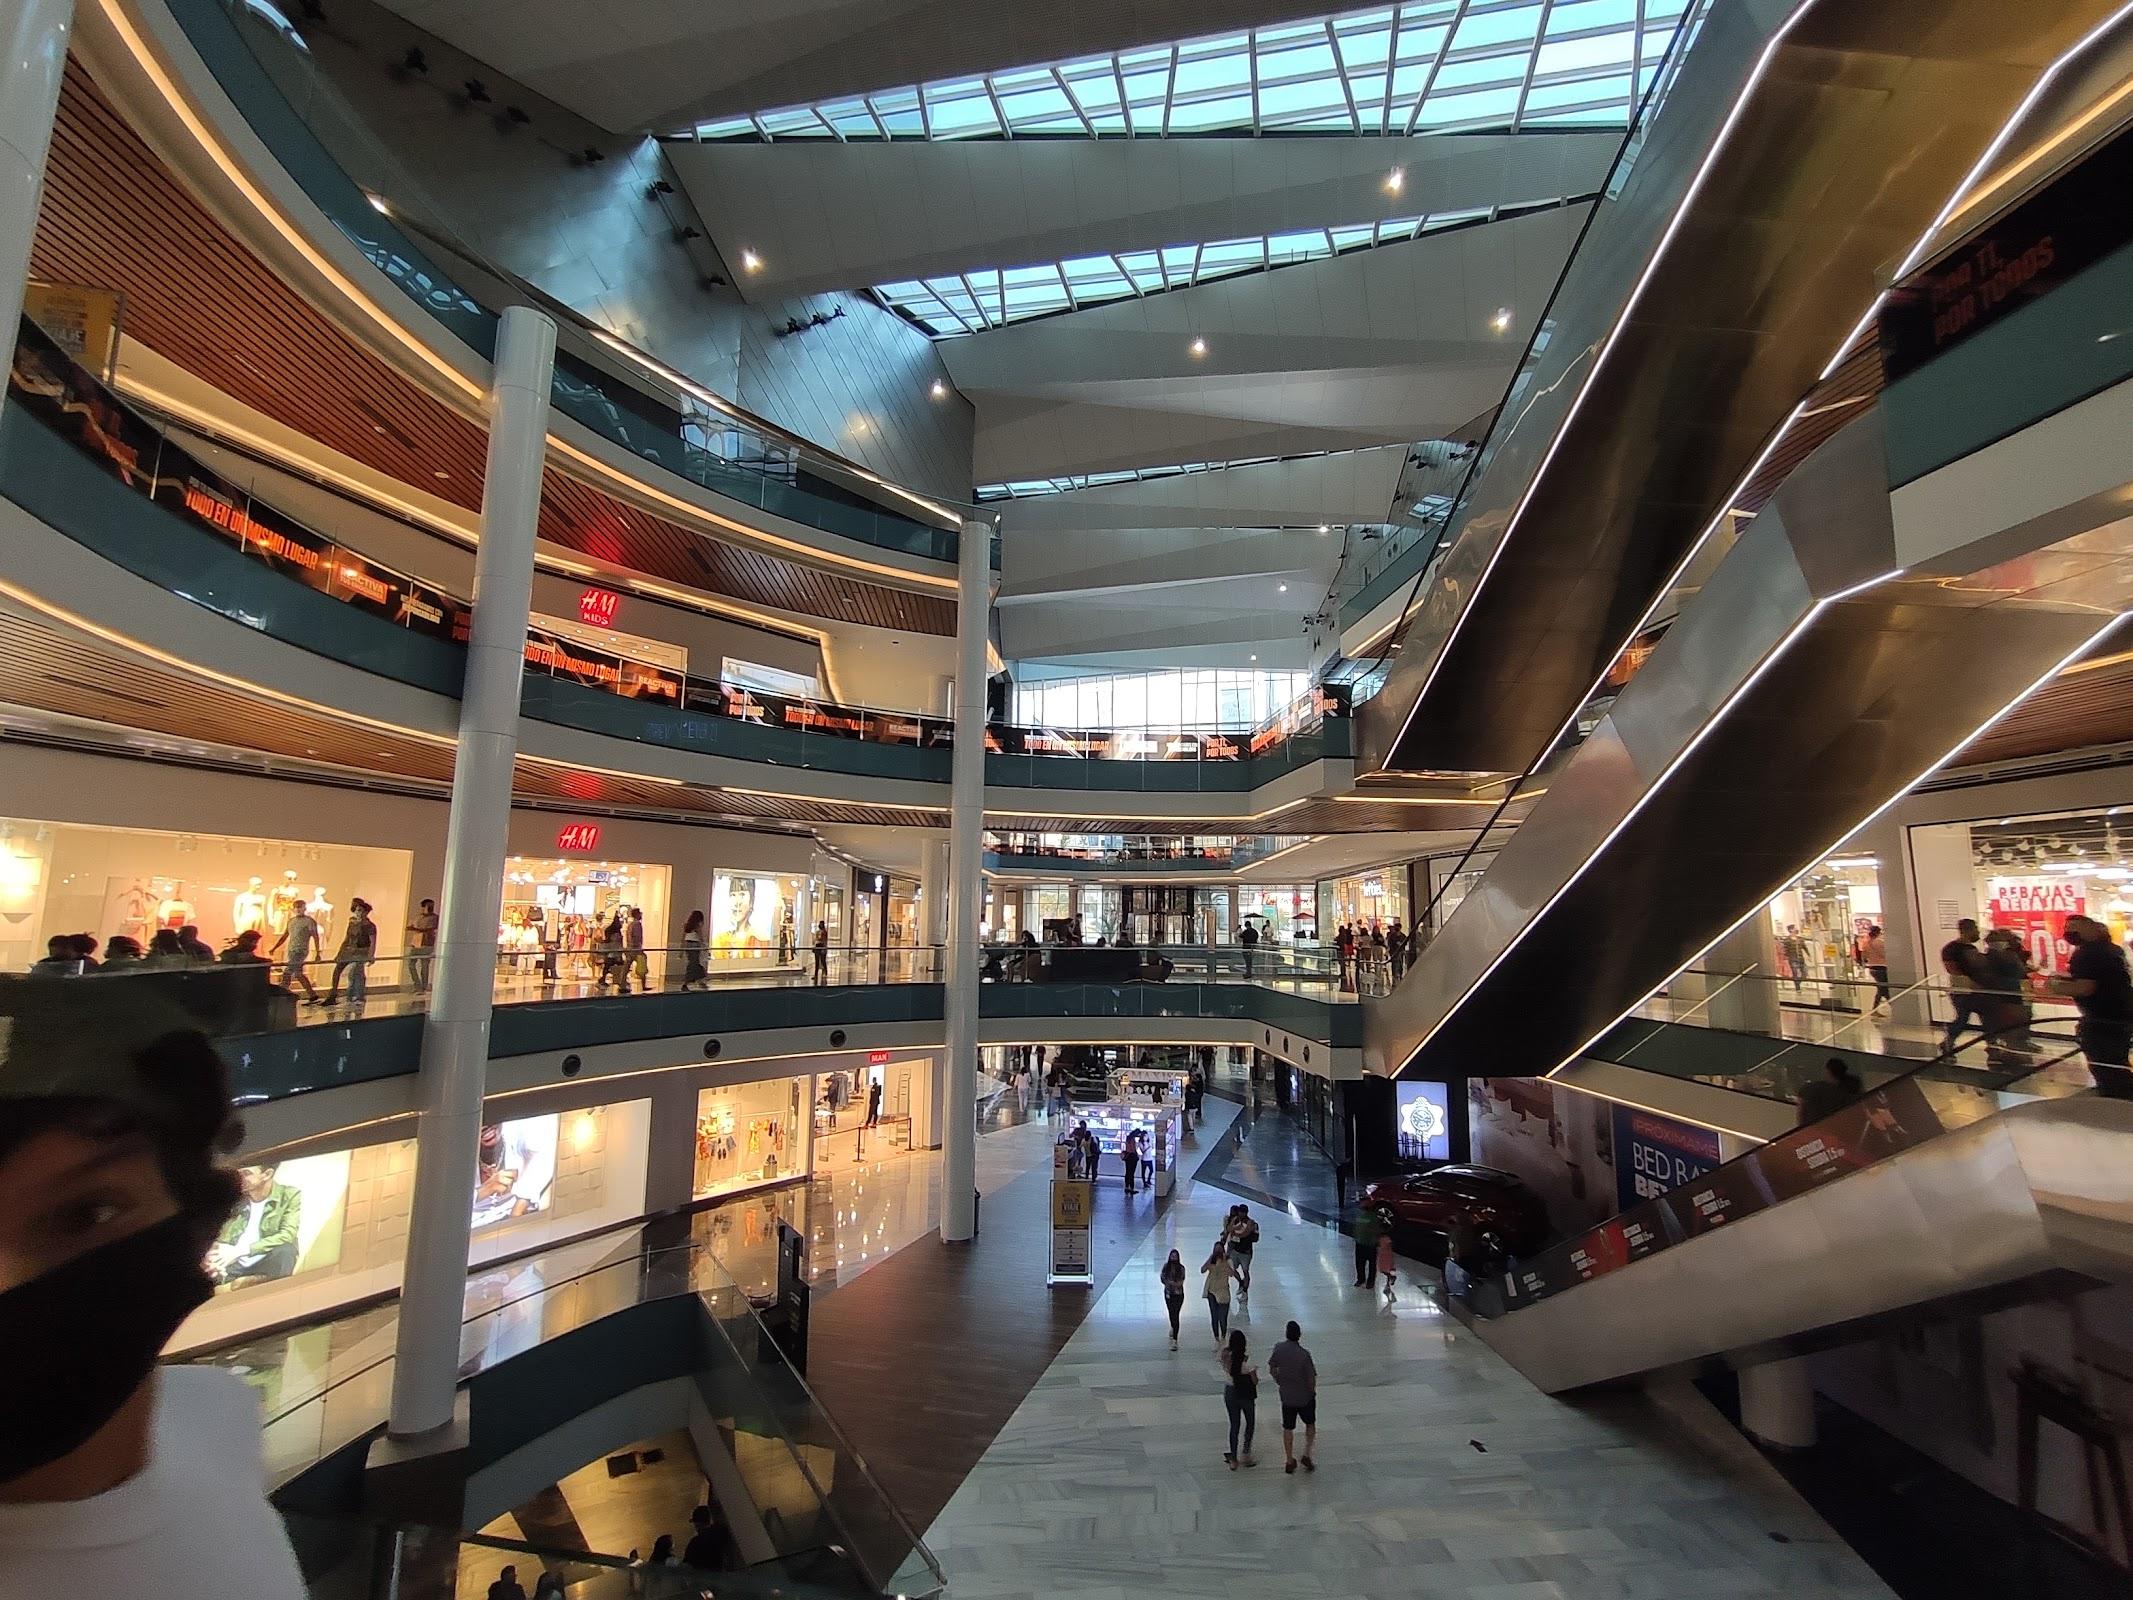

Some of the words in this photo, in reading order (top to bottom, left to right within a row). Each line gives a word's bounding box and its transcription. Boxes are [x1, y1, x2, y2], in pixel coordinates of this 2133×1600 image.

[186, 487, 215, 519] TODO
[214, 502, 231, 528] EN
[284, 540, 319, 570] LUGAR
[583, 612, 609, 625] KIDS
[524, 645, 541, 663] ODO
[560, 826, 597, 850] H&M
[1633, 1142, 1670, 1180] BED
[1675, 1158, 1710, 1187] BA
